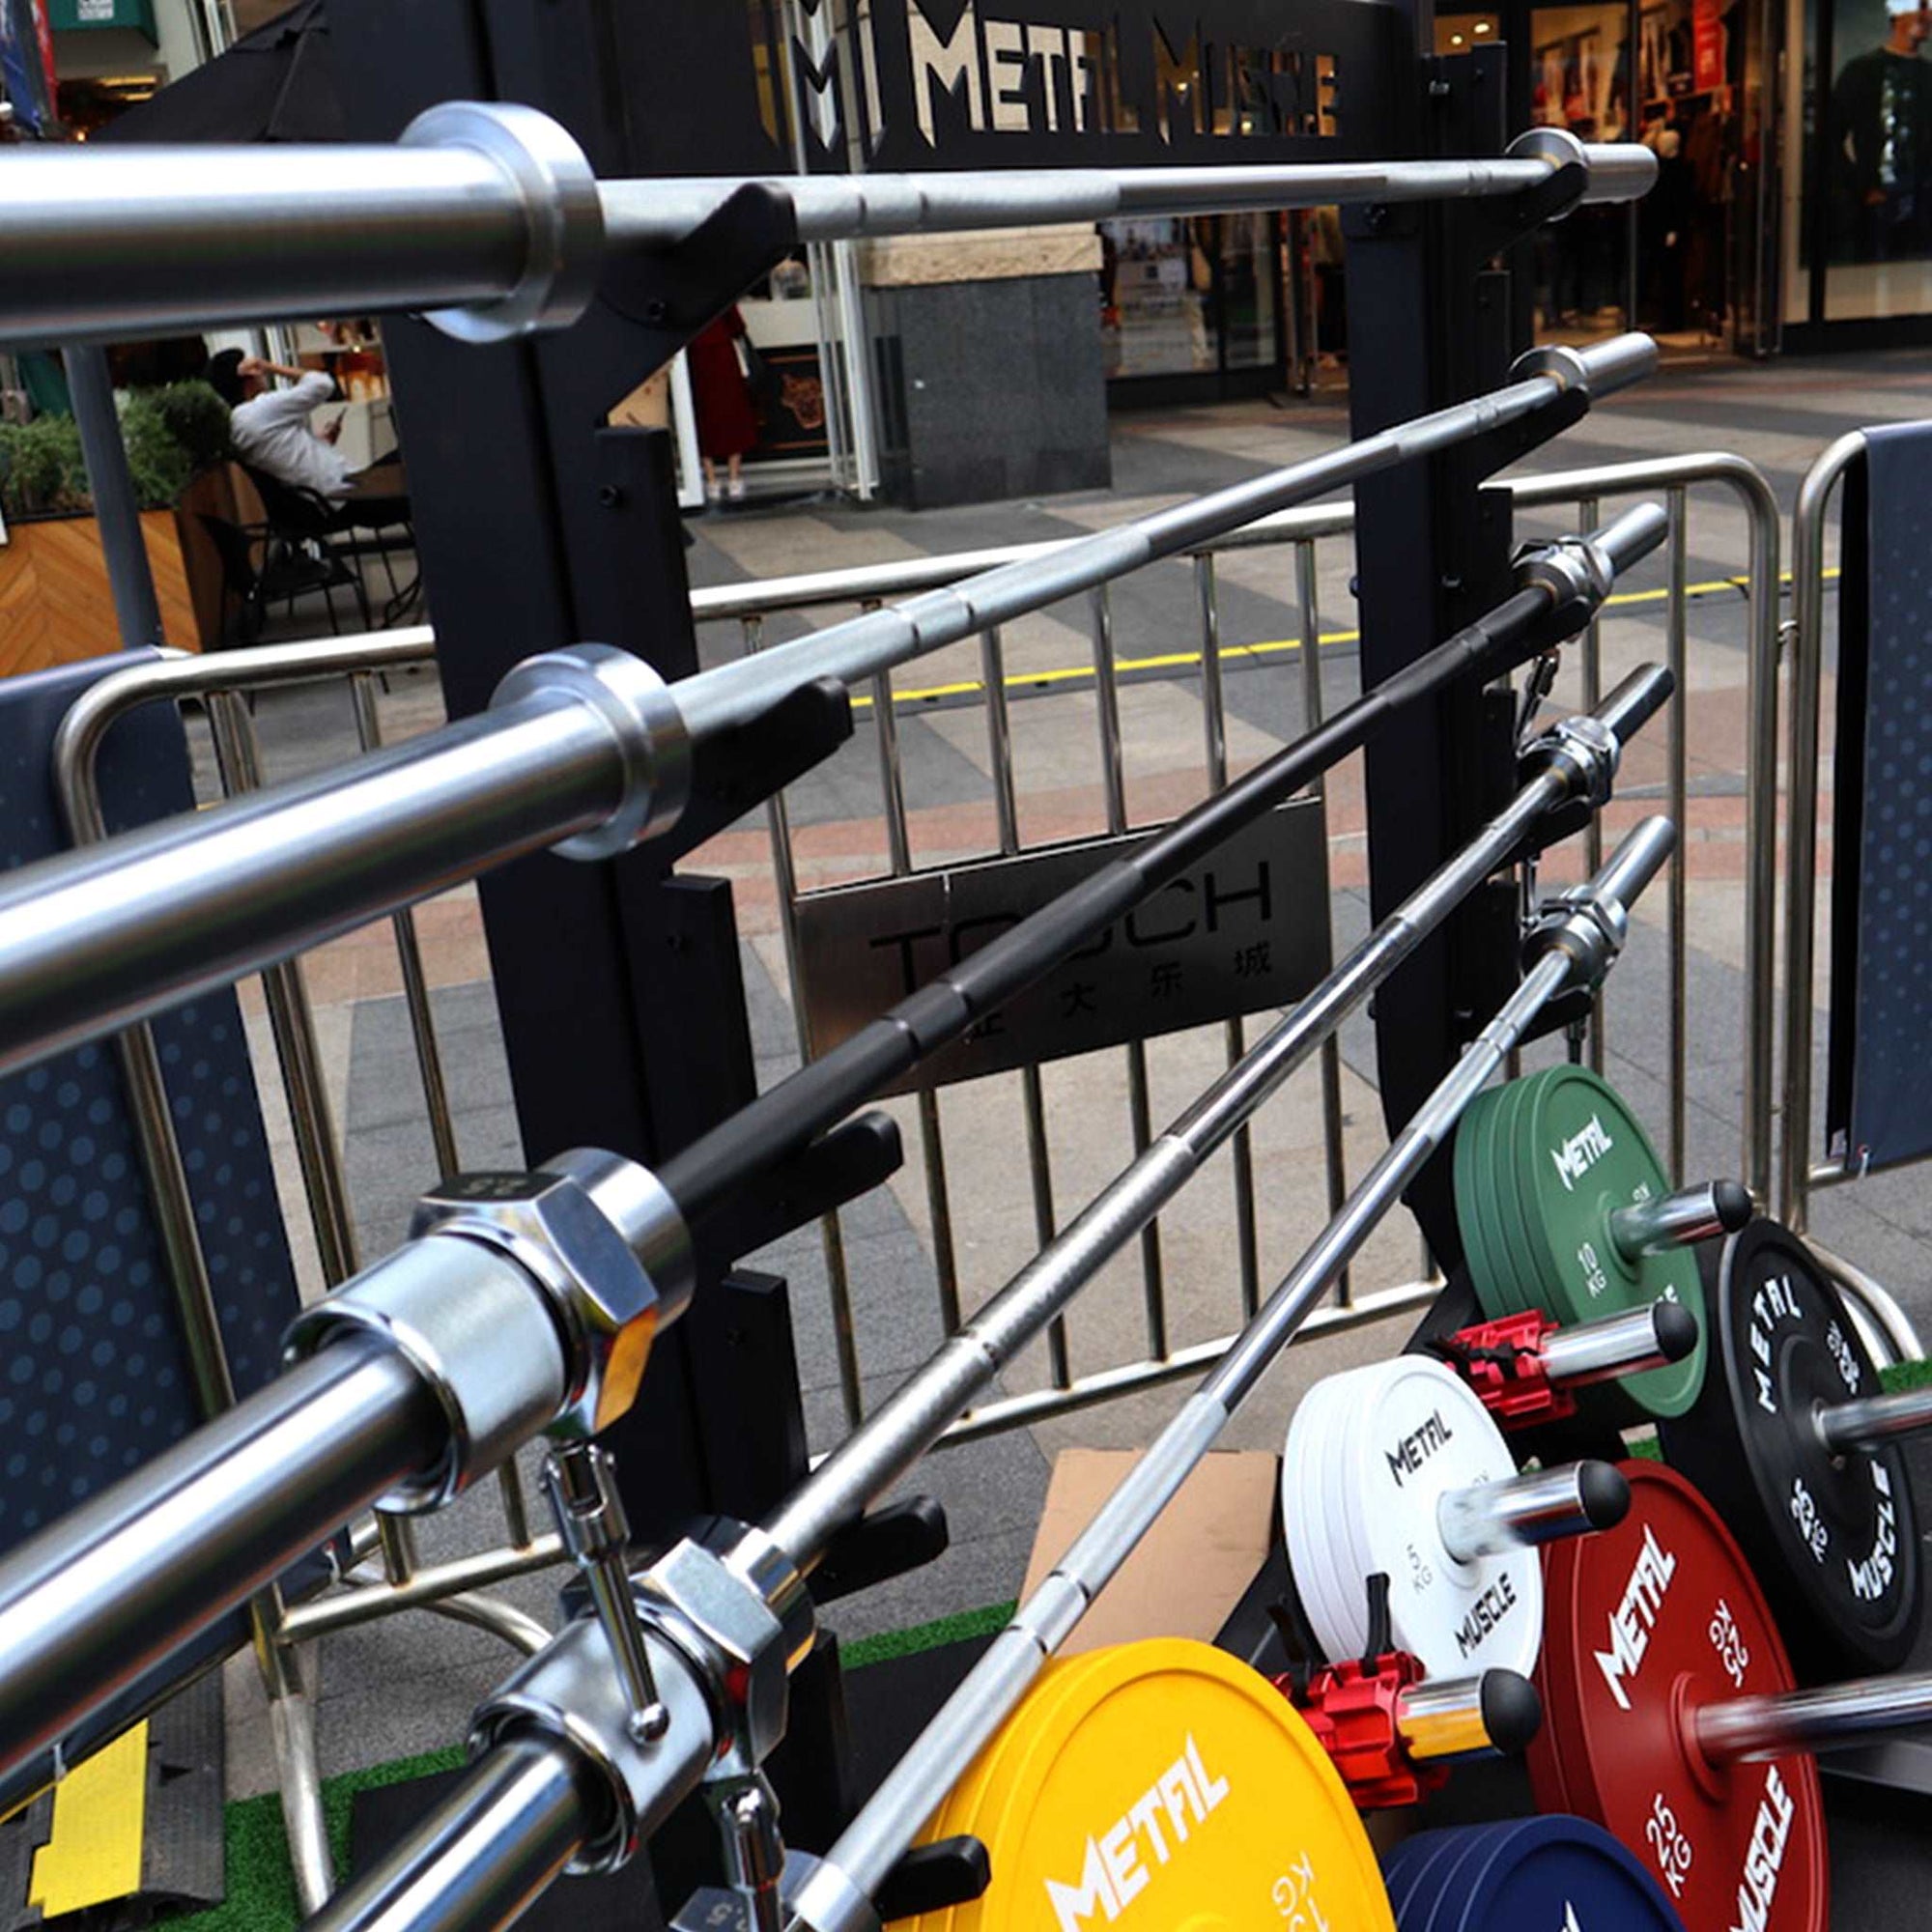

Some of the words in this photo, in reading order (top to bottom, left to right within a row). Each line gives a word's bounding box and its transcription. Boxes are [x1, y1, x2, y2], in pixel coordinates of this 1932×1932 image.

[1550, 1113, 1613, 1191] METAL
[1577, 1242, 1599, 1275] 10
[1585, 1268, 1607, 1298] KG
[1750, 1274, 1803, 1415] METAL
[1384, 1407, 1453, 1489] METAL
[1847, 1460, 1896, 1601] MUSCLE
[1411, 1565, 1434, 1595] KG
[1454, 1572, 1517, 1660] MUSCLE
[1594, 1522, 1676, 1710] METAL
[1043, 1729, 1231, 1932] METAL
[1646, 1793, 1678, 1870] 25
[1665, 1833, 1692, 1899] KG
[1271, 1850, 1315, 1917] KG
